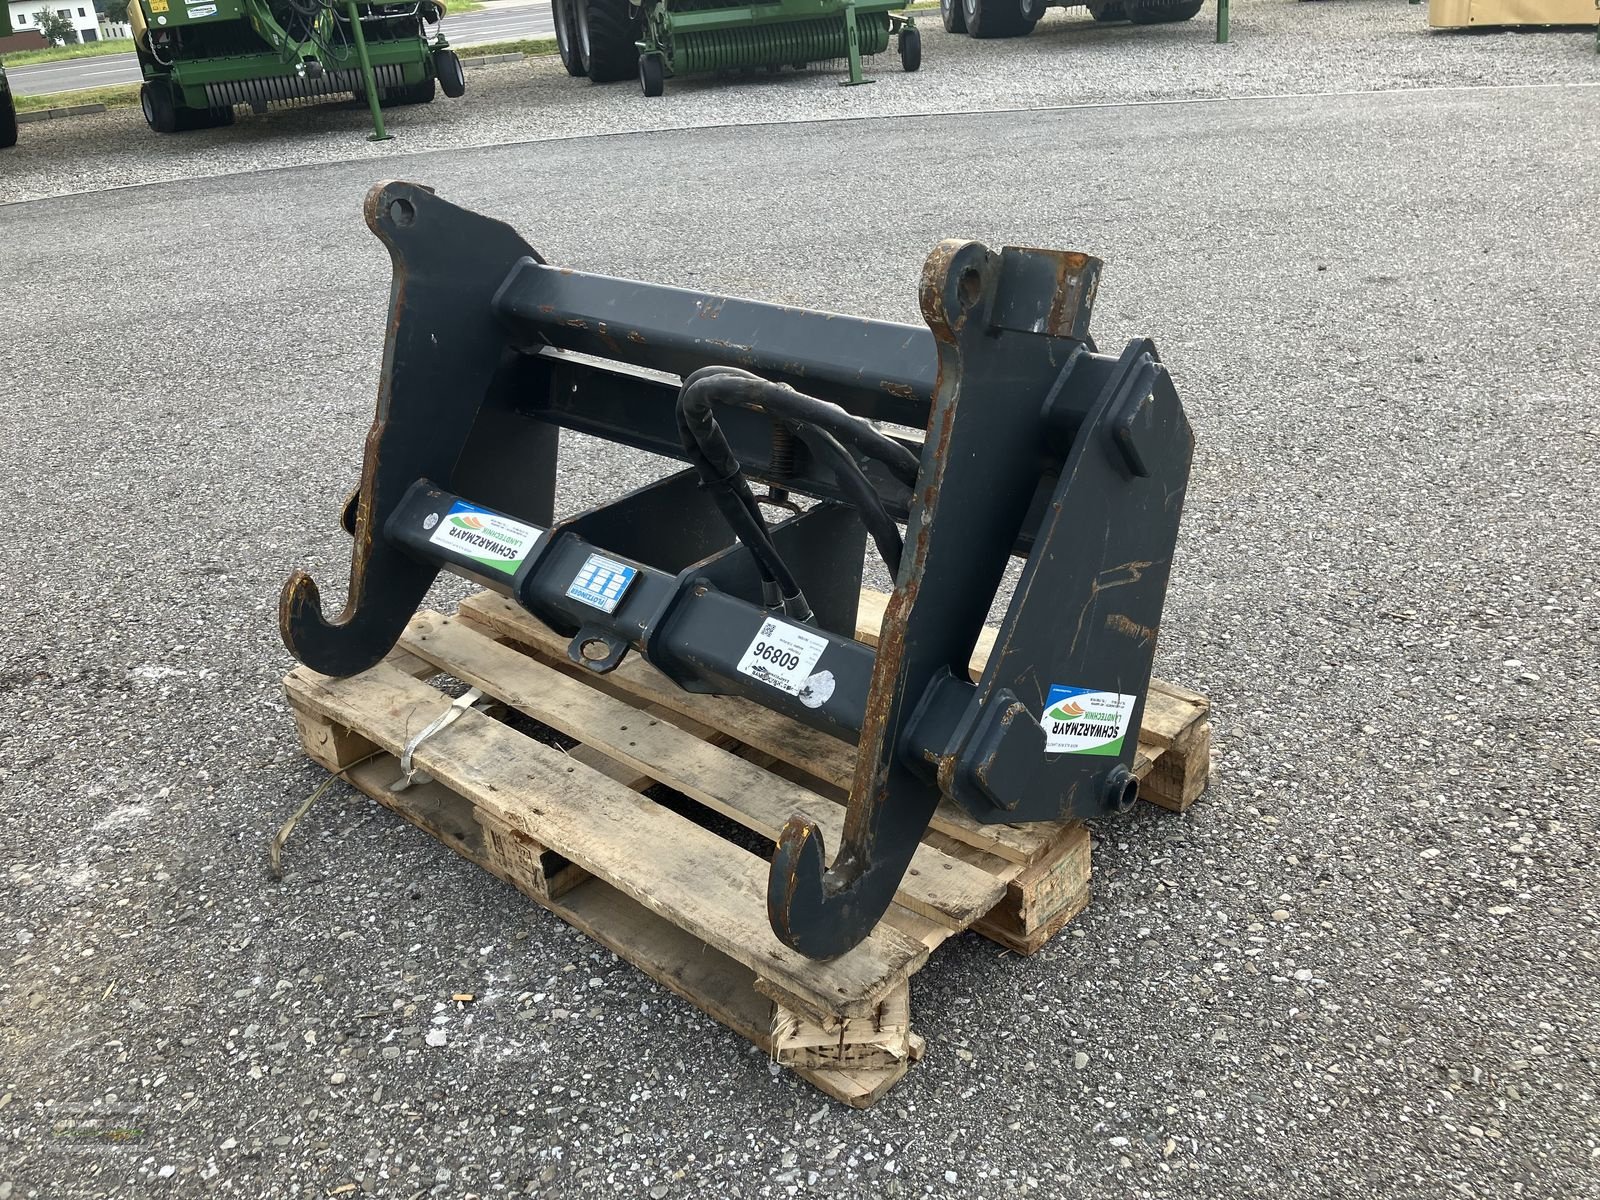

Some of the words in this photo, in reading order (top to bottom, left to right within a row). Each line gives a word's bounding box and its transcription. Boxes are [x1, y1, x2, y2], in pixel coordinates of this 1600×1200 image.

[448, 526, 519, 560] SCHWARZMAYR
[481, 527, 523, 548] LANDTECHNIK
[753, 641, 800, 671] 60896
[1084, 711, 1122, 723] LANDTECHNIK
[1052, 721, 1120, 739] SCHWARZMAYR
